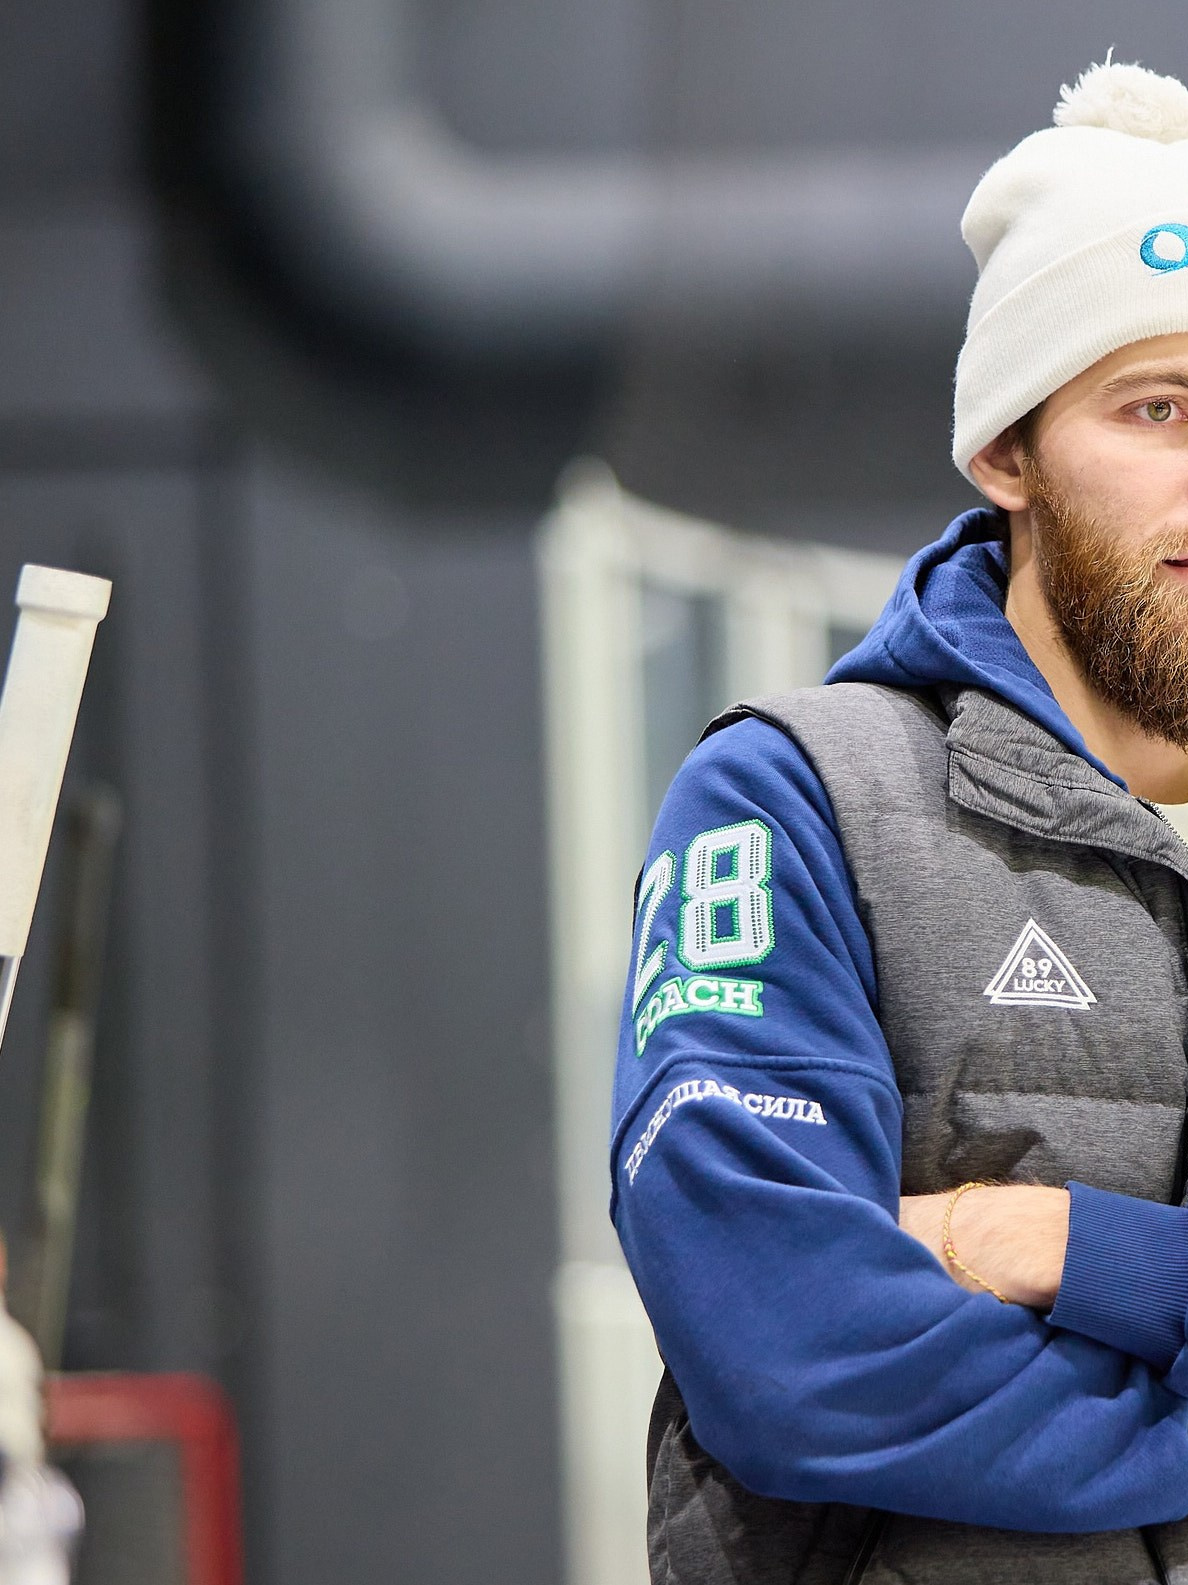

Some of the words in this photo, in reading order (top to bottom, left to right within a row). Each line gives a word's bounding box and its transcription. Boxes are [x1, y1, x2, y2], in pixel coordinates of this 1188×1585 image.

[632, 818, 775, 1021] 28
[1021, 957, 1053, 978] 89
[1013, 978, 1067, 993] LUCKY
[635, 975, 764, 1058] COACH
[742, 1092, 829, 1126] СИЛА
